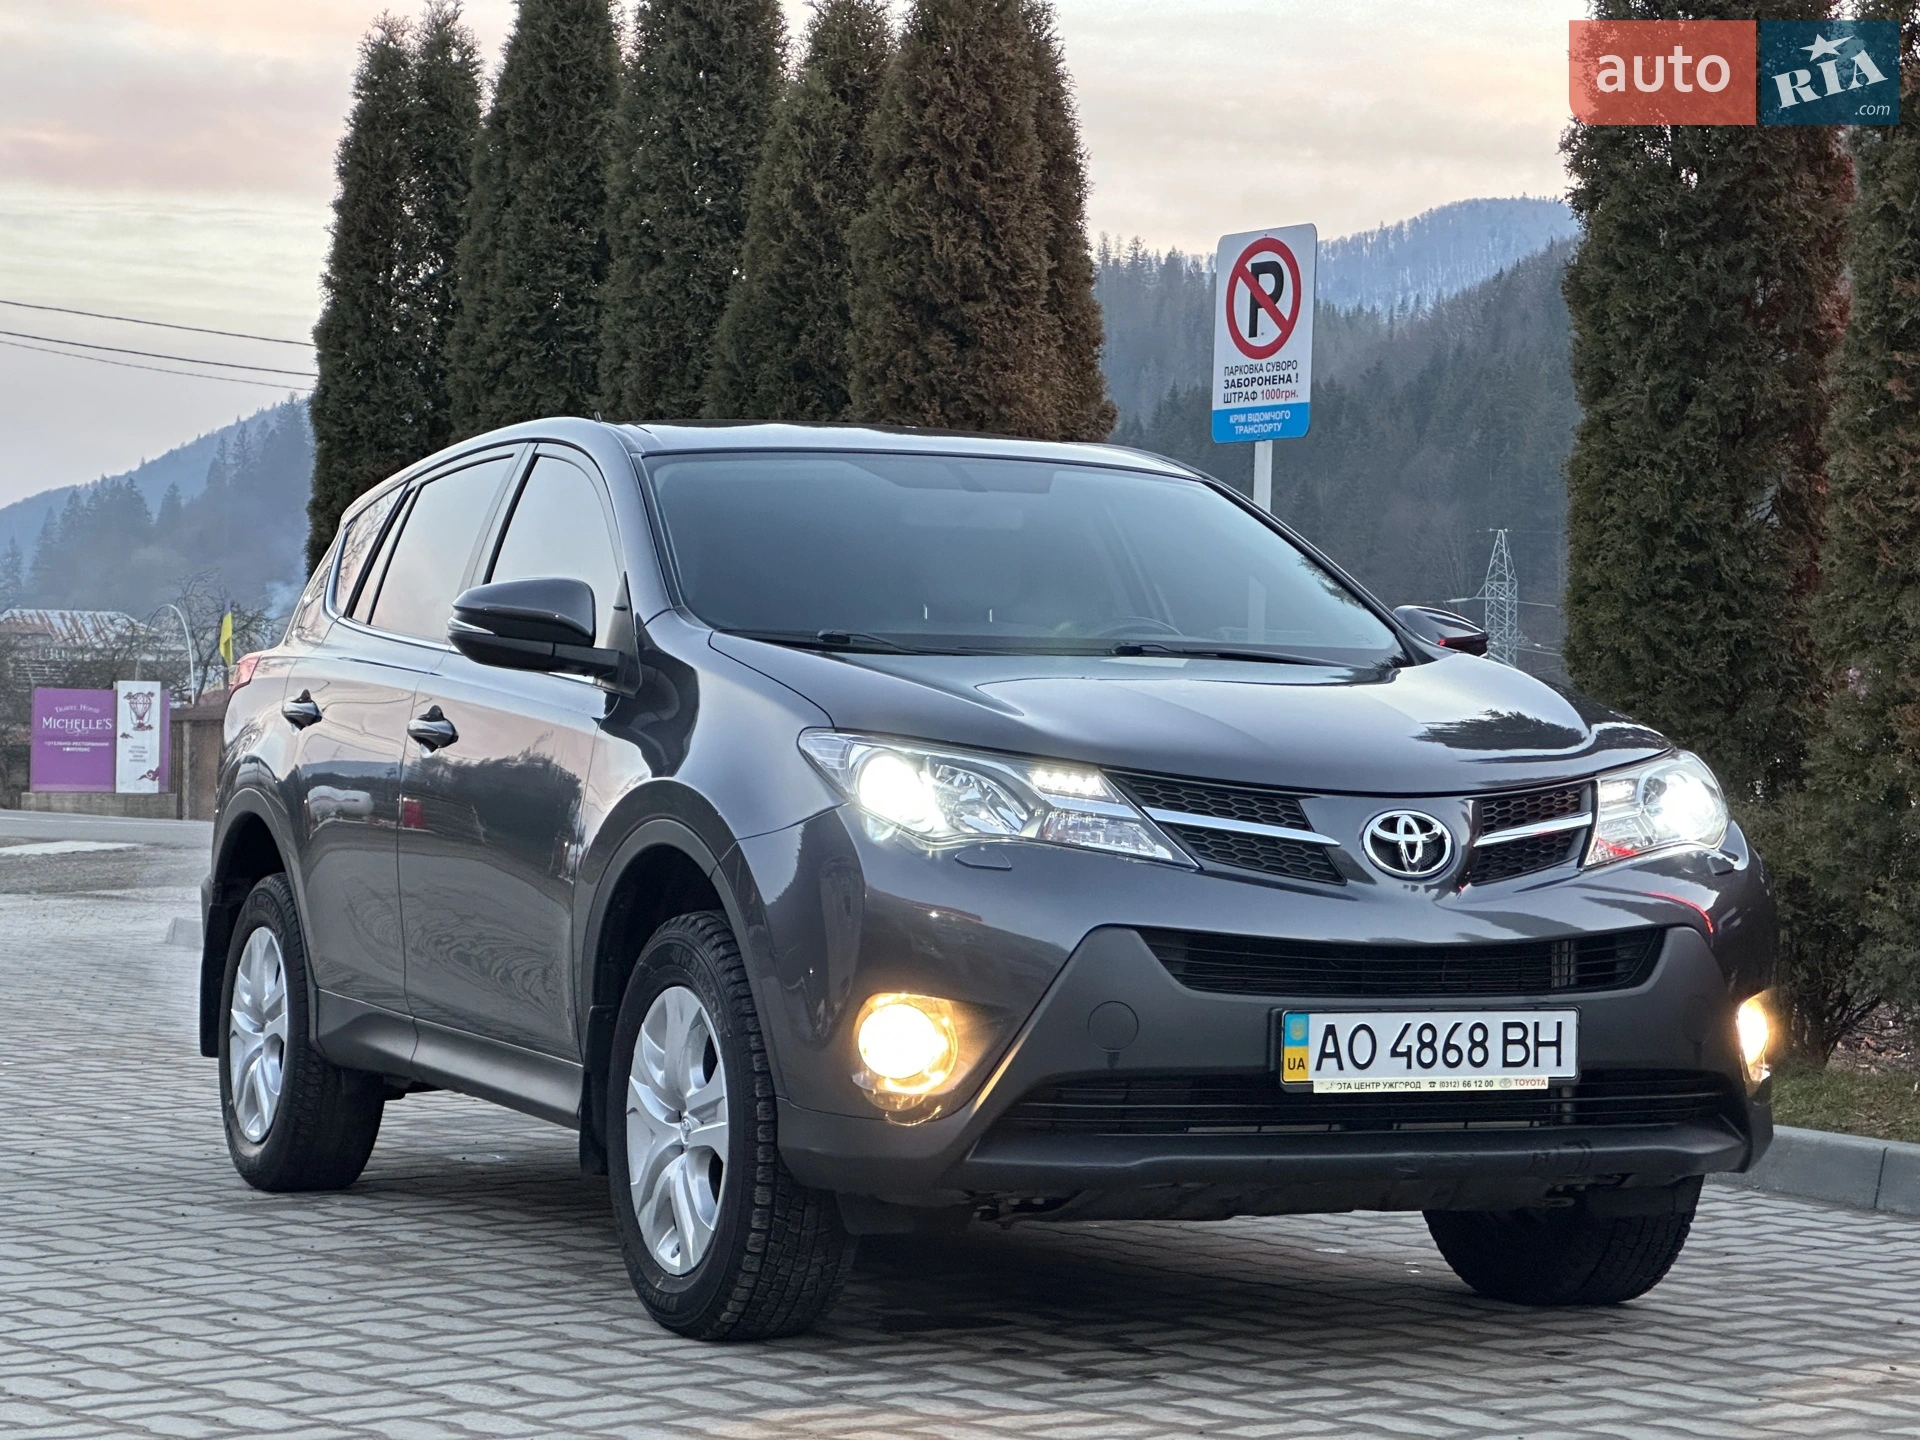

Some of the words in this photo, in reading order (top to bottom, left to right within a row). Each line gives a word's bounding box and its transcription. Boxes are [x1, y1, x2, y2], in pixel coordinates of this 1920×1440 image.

[1224, 362, 1264, 376] ПАРКОВКА
[1265, 360, 1298, 373] СУВОРО
[1224, 373, 1293, 389] ЗАБОРОНЕНА
[1223, 391, 1258, 404] ШТРАФ
[1261, 388, 1298, 401] 1000грн.
[1229, 413, 1246, 424] КРІМ
[1247, 410, 1291, 423] ВІДОМЧОГО
[1234, 422, 1282, 435] ТРАНСПОРТУ
[1390, 1022, 1489, 1069] 4868
[1287, 1057, 1306, 1070] UA
[1354, 1081, 1381, 1090] ЦЕНТР
[1439, 1080, 1459, 1088] (0312)
[1462, 1079, 1472, 1088] 66
[1474, 1079, 1483, 1088] 12
[1484, 1079, 1494, 1088] 00
[1514, 1078, 1546, 1087] TOYOTA
